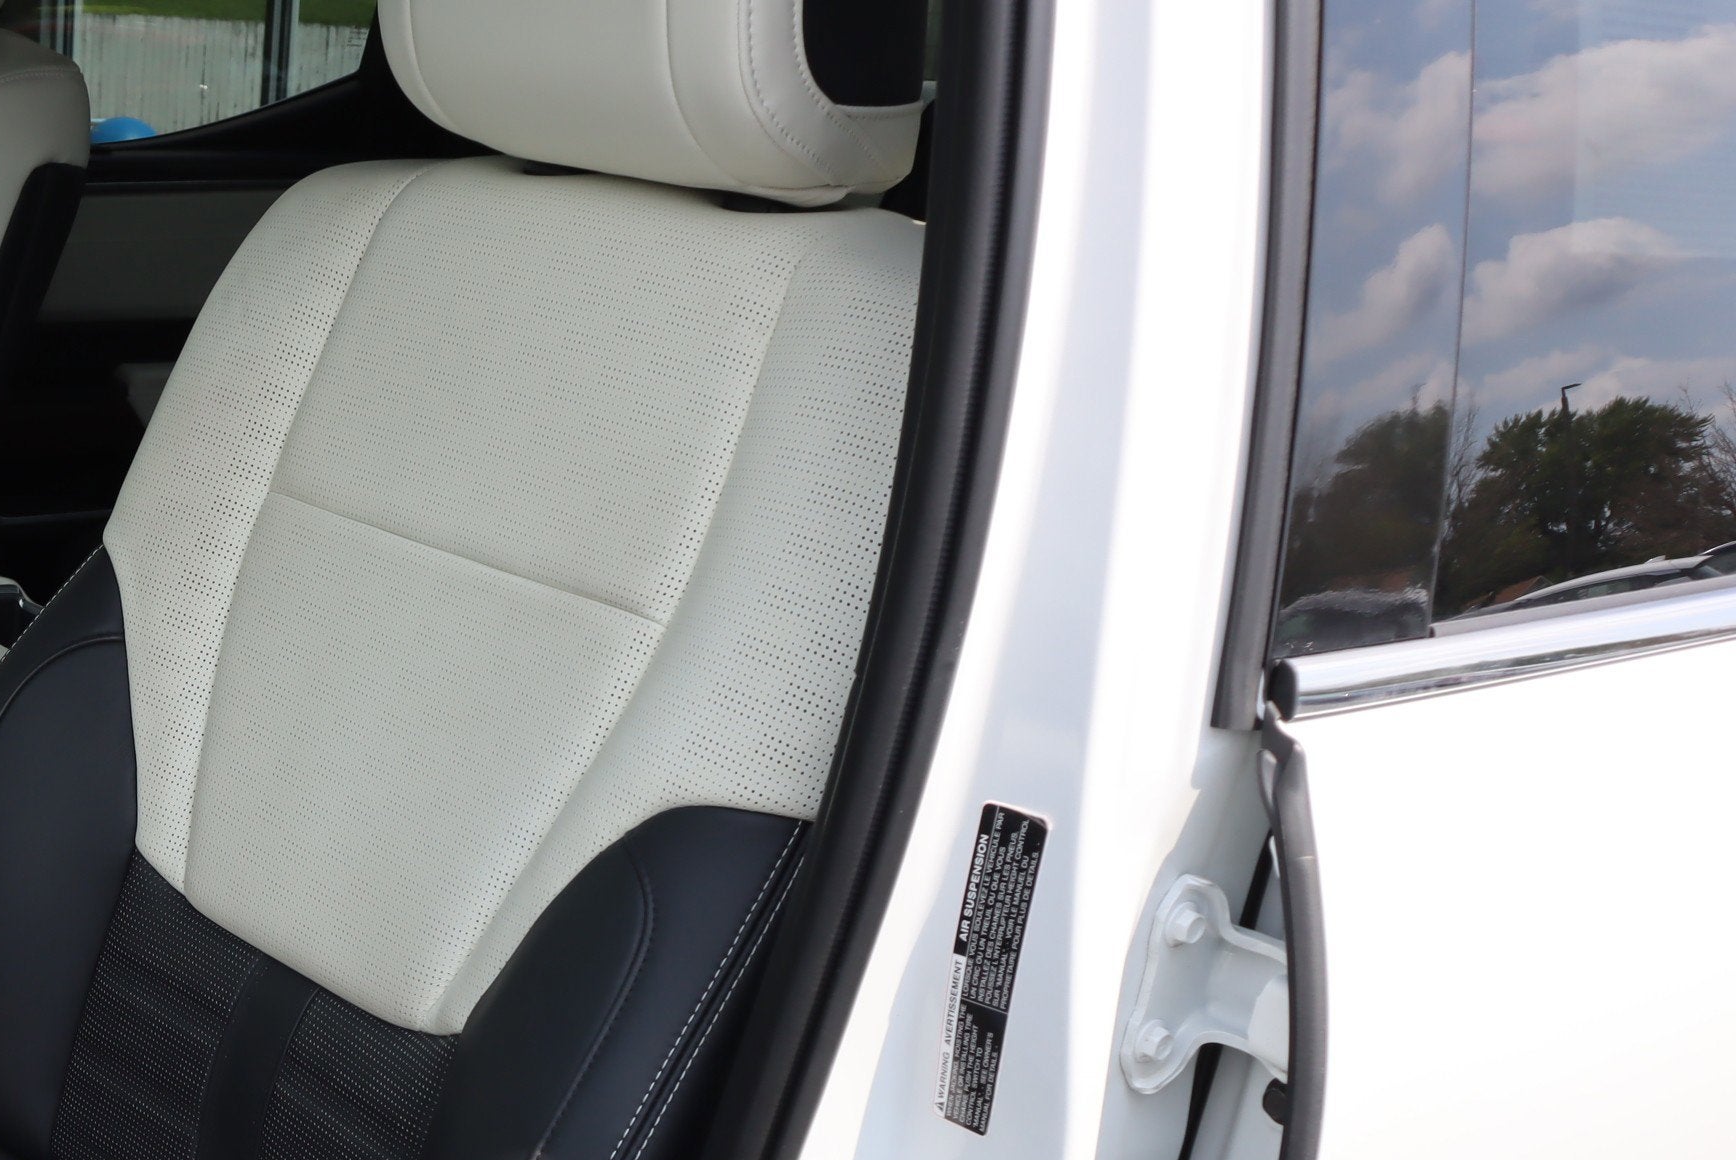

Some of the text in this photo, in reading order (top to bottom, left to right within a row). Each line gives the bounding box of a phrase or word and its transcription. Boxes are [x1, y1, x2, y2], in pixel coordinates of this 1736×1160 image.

[995, 847, 1006, 870] VOUS
[959, 834, 989, 941] AIR SUSPENSION
[991, 873, 1000, 891] QUE
[997, 882, 1007, 900] SUR
[1002, 864, 1011, 881] LES
[988, 892, 995, 905] OU
[1010, 907, 1017, 917] LE
[1012, 925, 1022, 949] POUR
[1017, 902, 1027, 924] PLUS
[1023, 888, 1030, 900] DE
[969, 933, 978, 955] VOUS
[978, 938, 986, 950] UN
[976, 952, 983, 964] OU
[970, 987, 977, 999] UN
[938, 961, 962, 1098] WARNING AVERTISSEMENT
